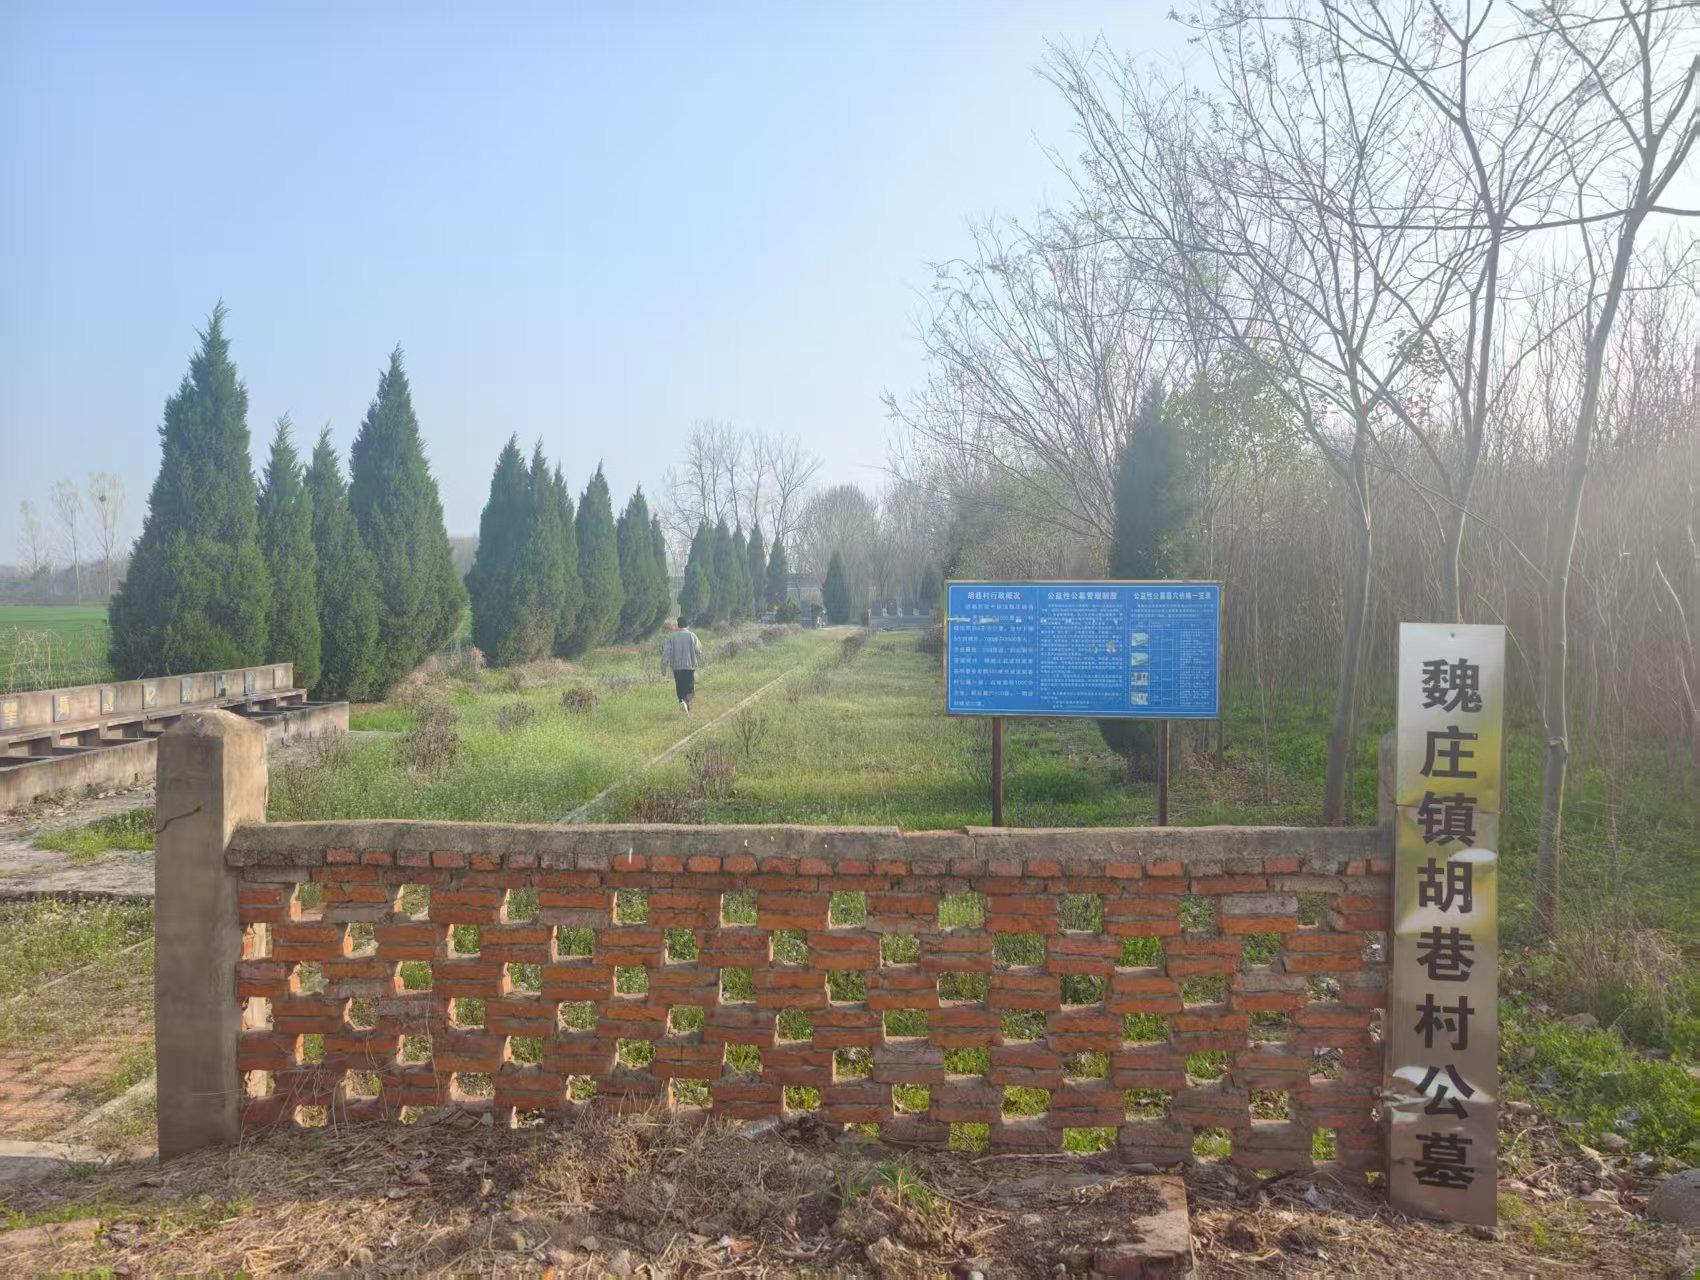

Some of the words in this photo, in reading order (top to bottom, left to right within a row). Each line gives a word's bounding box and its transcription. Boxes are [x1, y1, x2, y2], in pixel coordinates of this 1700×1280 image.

[1413, 657, 1483, 1193] 魏庄镇胡巷村公墓
